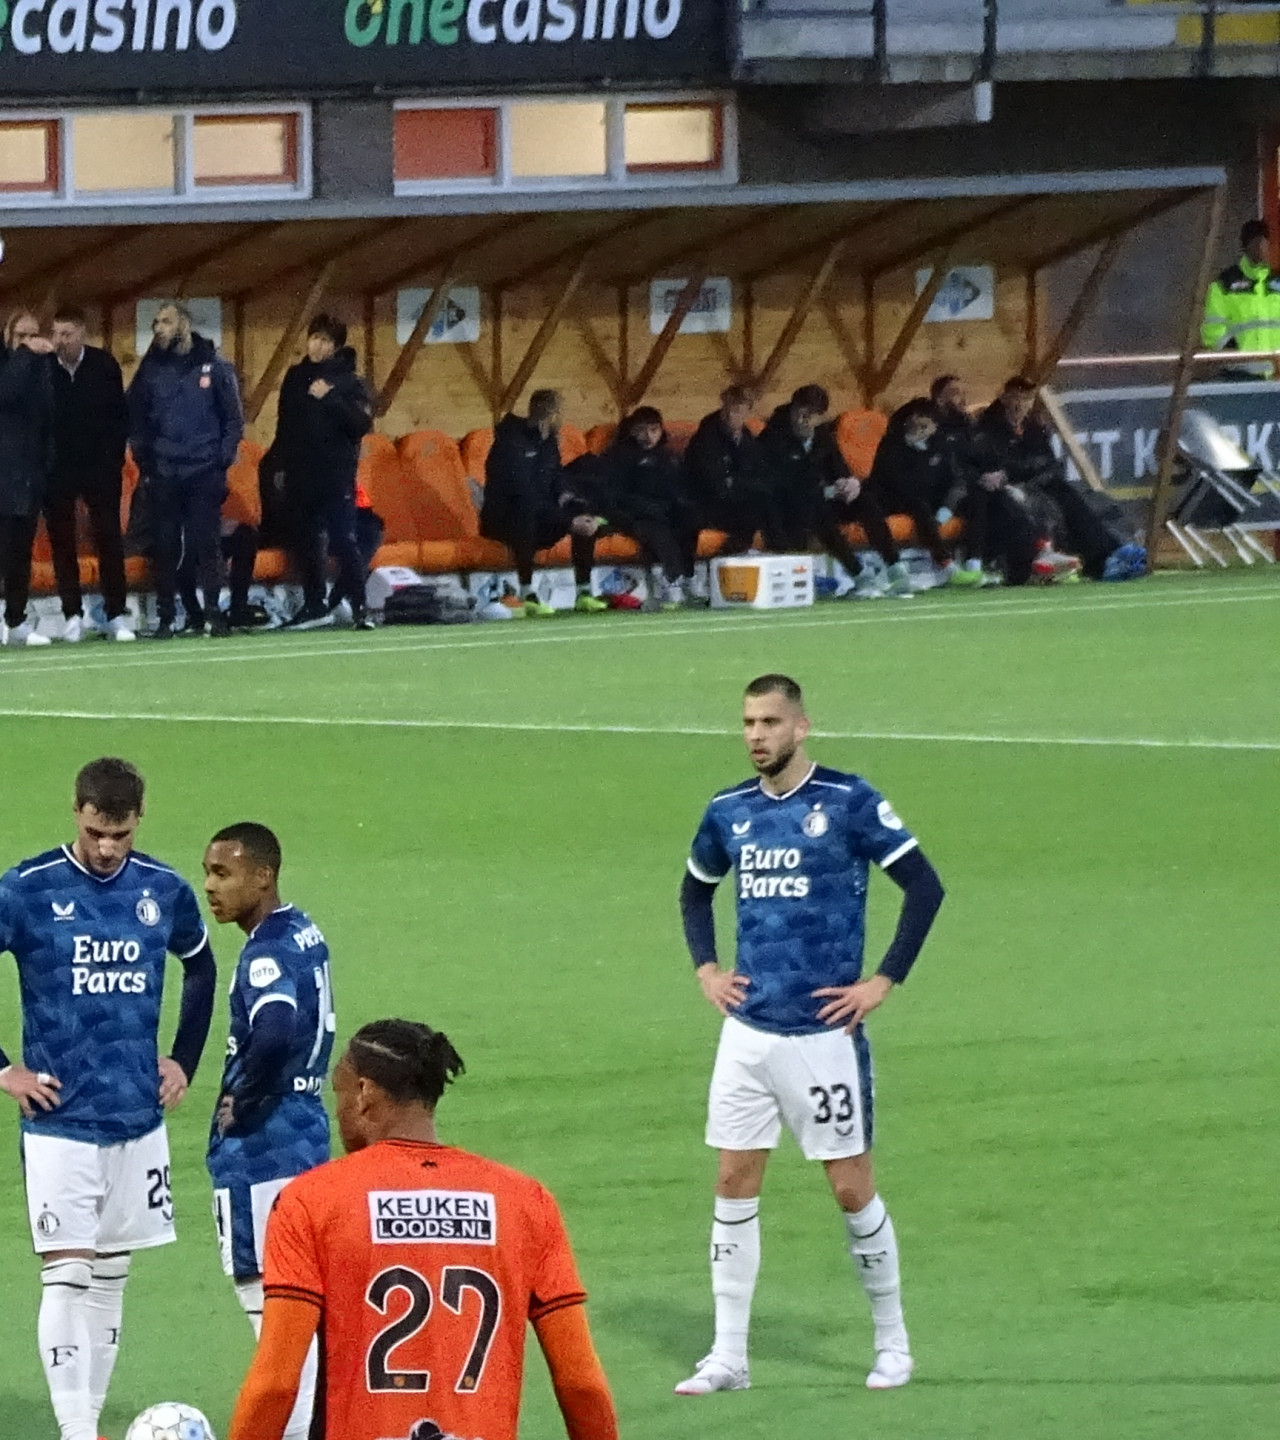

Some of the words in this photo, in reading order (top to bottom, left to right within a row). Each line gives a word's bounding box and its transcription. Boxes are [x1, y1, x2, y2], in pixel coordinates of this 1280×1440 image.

[741, 844, 800, 870] Euro
[741, 873, 809, 898] Parcs
[72, 935, 140, 963] Euro
[72, 967, 146, 995] Parcs
[810, 1083, 853, 1123] 33
[377, 1197, 489, 1218] KEUKEN
[378, 1219, 490, 1239] LOODS.NL
[365, 1265, 501, 1393] 27
